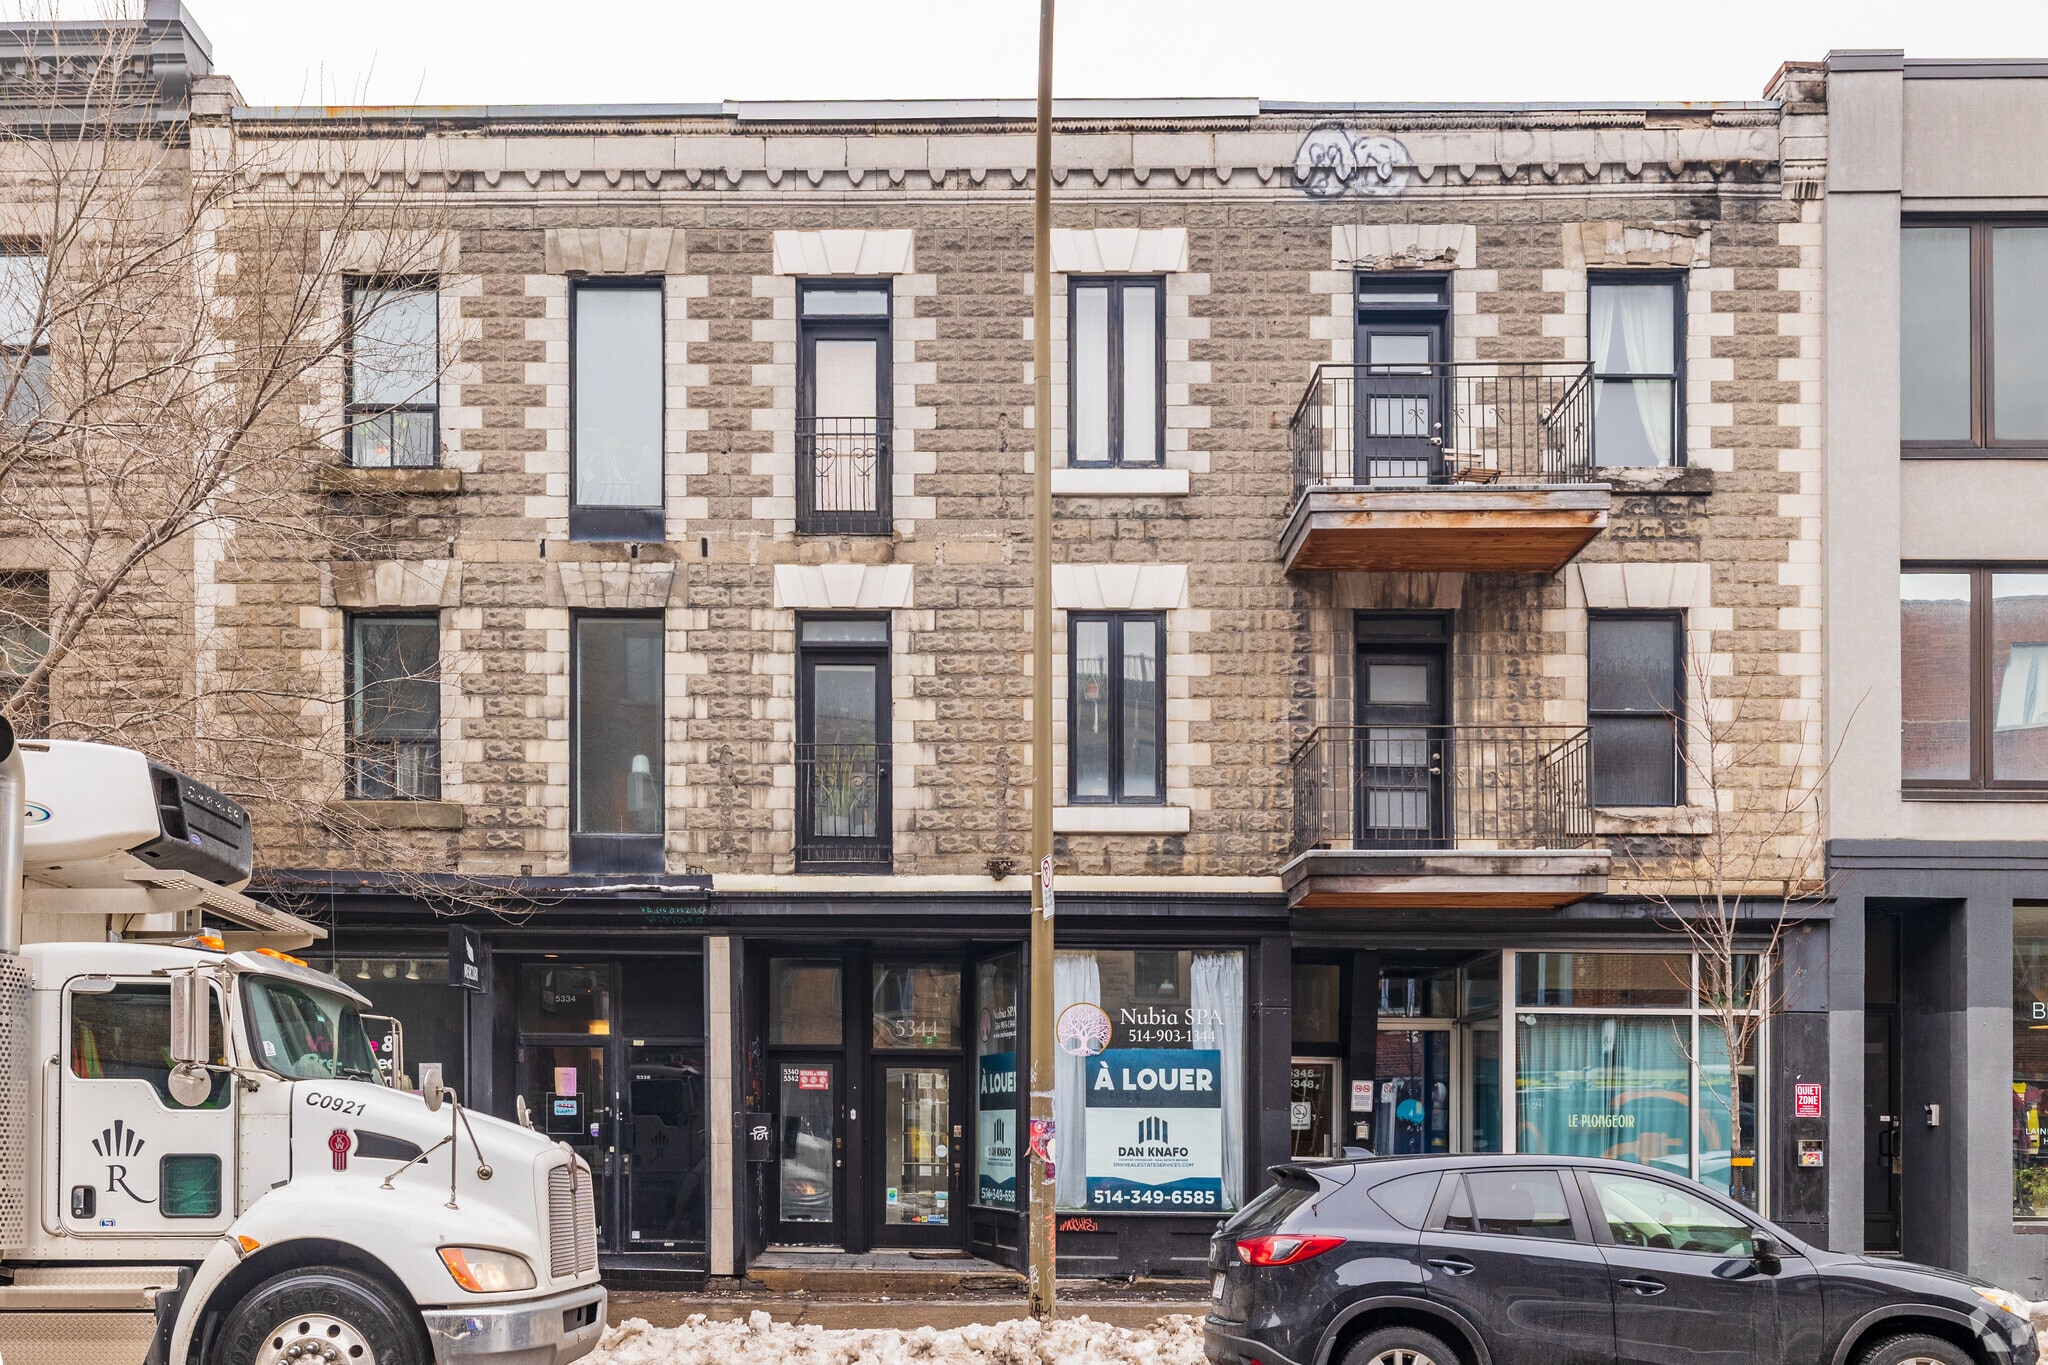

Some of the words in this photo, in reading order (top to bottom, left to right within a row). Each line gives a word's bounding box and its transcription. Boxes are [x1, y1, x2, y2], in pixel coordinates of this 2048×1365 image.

[555, 995, 576, 1003] 5334
[1120, 1006, 1178, 1025] Nubia
[1184, 1008, 1224, 1026] SPA
[895, 1020, 938, 1037] 5344
[1129, 1029, 1216, 1043] 514-903-1344
[783, 1068, 799, 1076] 5340
[1094, 1061, 1115, 1091] À
[1122, 1068, 1213, 1091] LOUER
[981, 1068, 988, 1094] À
[1797, 1086, 1820, 1096] QUIET
[306, 1092, 367, 1117] C0921
[1798, 1095, 1819, 1105] ZONE
[1568, 1114, 1578, 1128] LE
[1581, 1114, 1635, 1128] PLONGEOIR
[2025, 1127, 2048, 1135] LAIN
[1118, 1147, 1144, 1157] DAN
[1148, 1147, 1189, 1157] KNAFO
[1094, 1190, 1215, 1205] 514-349-6585
